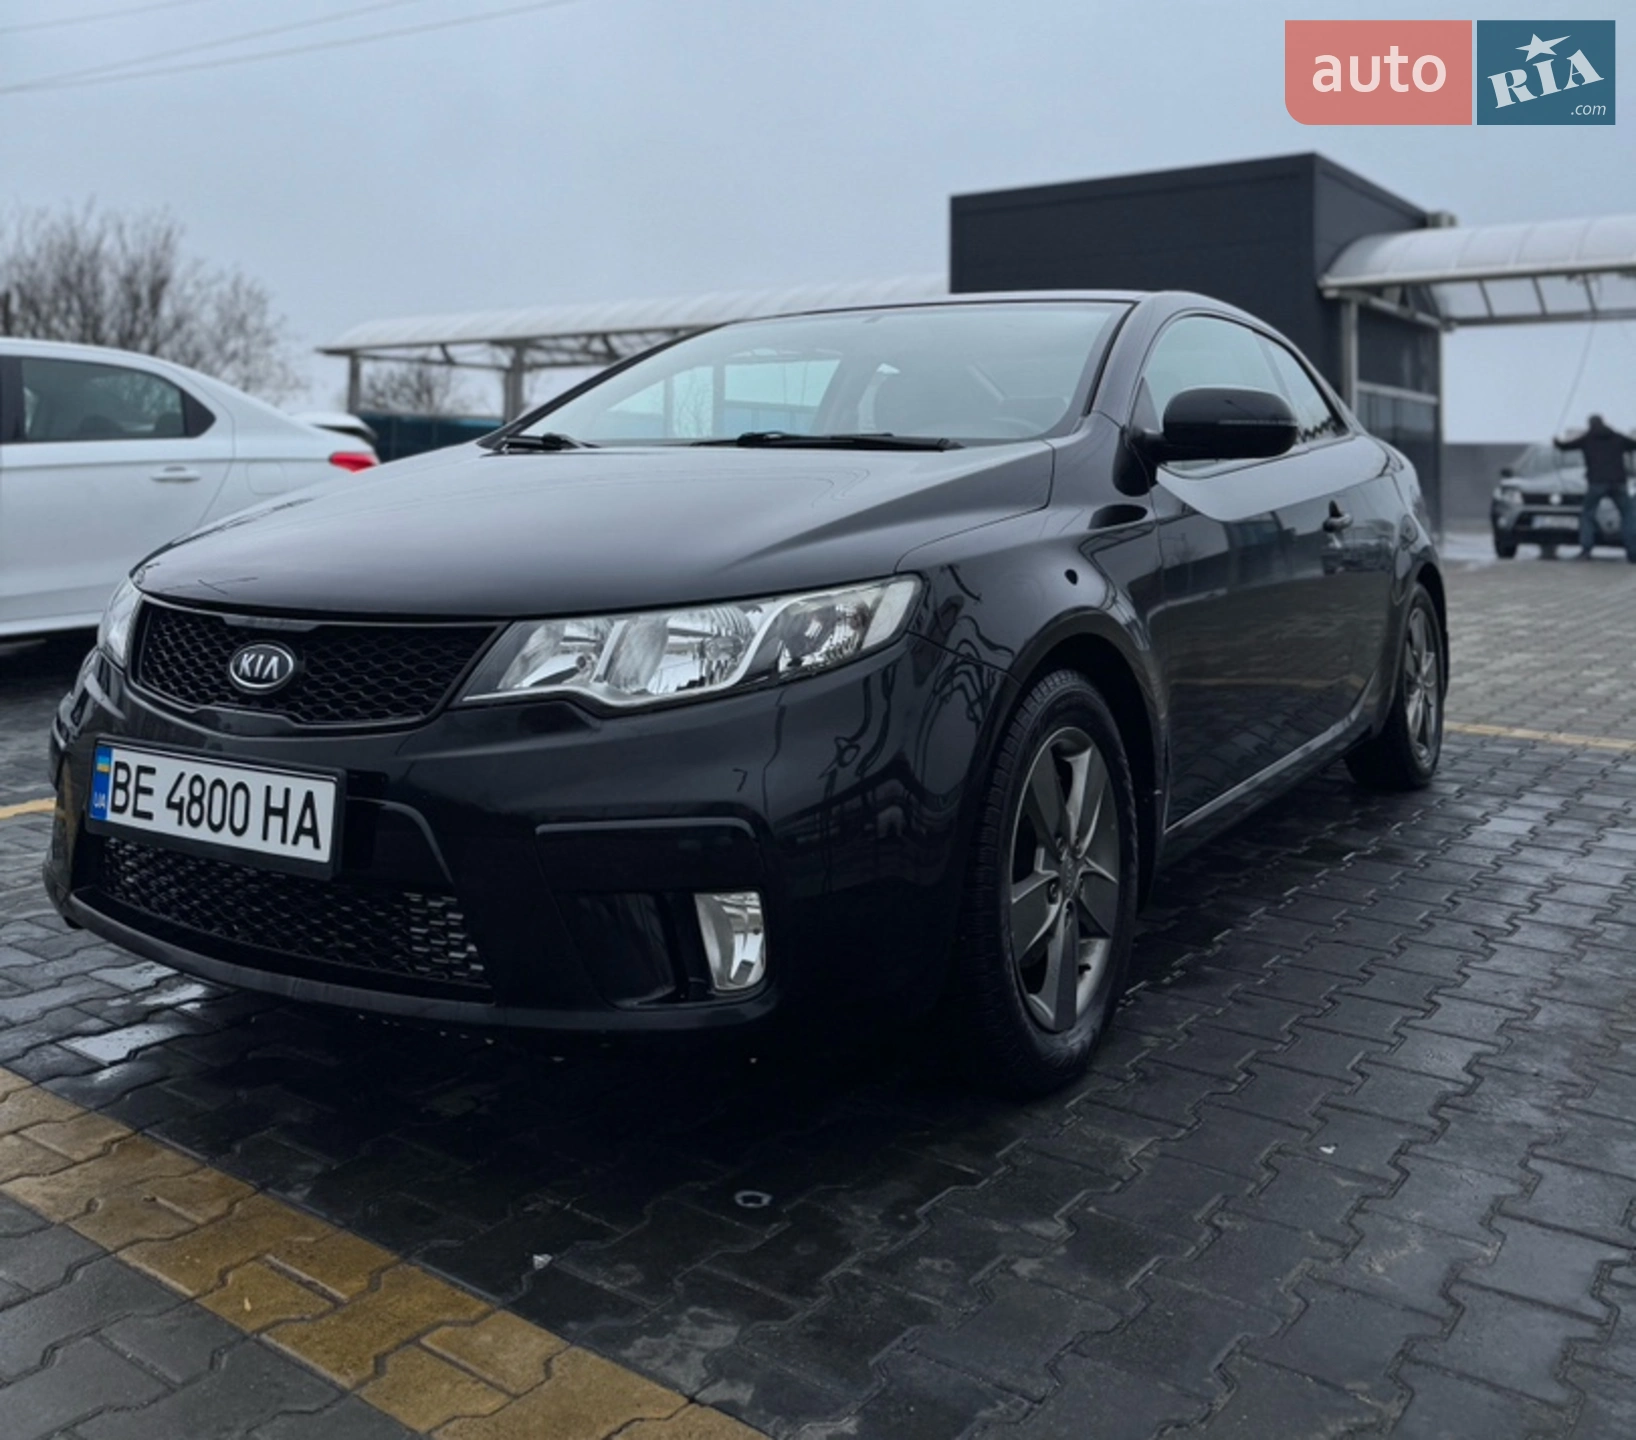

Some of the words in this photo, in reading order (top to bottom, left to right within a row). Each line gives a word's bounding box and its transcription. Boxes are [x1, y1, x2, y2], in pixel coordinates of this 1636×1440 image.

[239, 653, 279, 679] KIA
[110, 760, 156, 821] BE
[165, 771, 250, 837] 4800
[262, 784, 321, 850] HA
